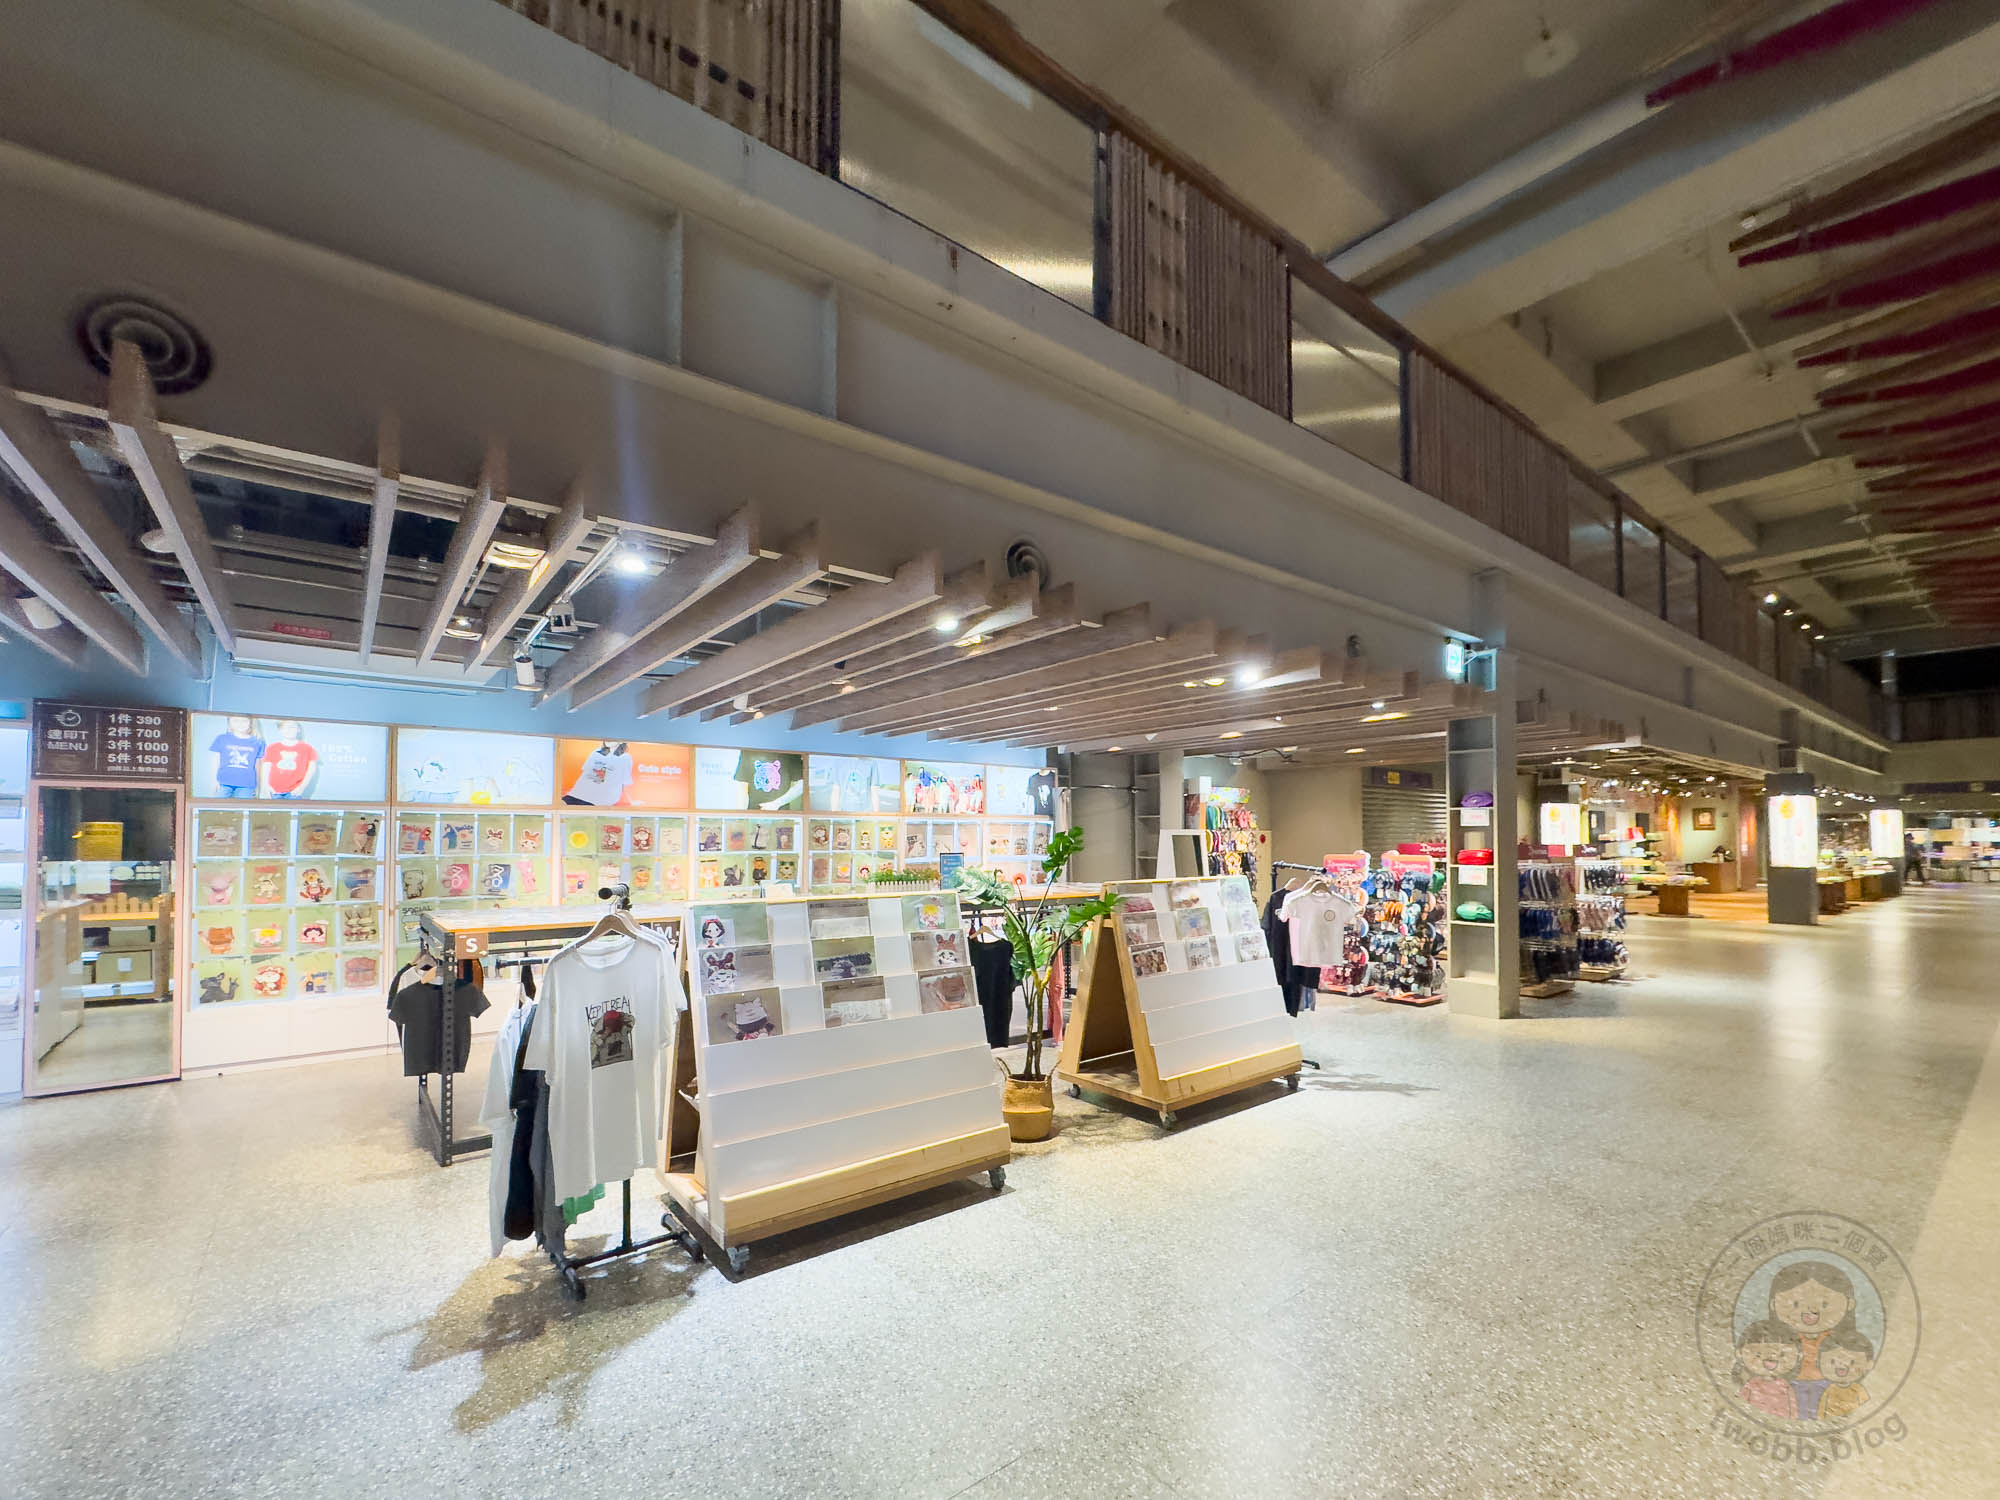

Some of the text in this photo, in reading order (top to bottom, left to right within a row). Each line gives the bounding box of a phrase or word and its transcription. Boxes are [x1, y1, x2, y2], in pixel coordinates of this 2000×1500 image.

[108, 713, 161, 725] 1件 390
[107, 727, 161, 738] 2件 700
[47, 741, 89, 751] MENU
[107, 740, 169, 752] 3件 1000
[107, 753, 169, 765] 5件 1500
[465, 937, 479, 953] S
